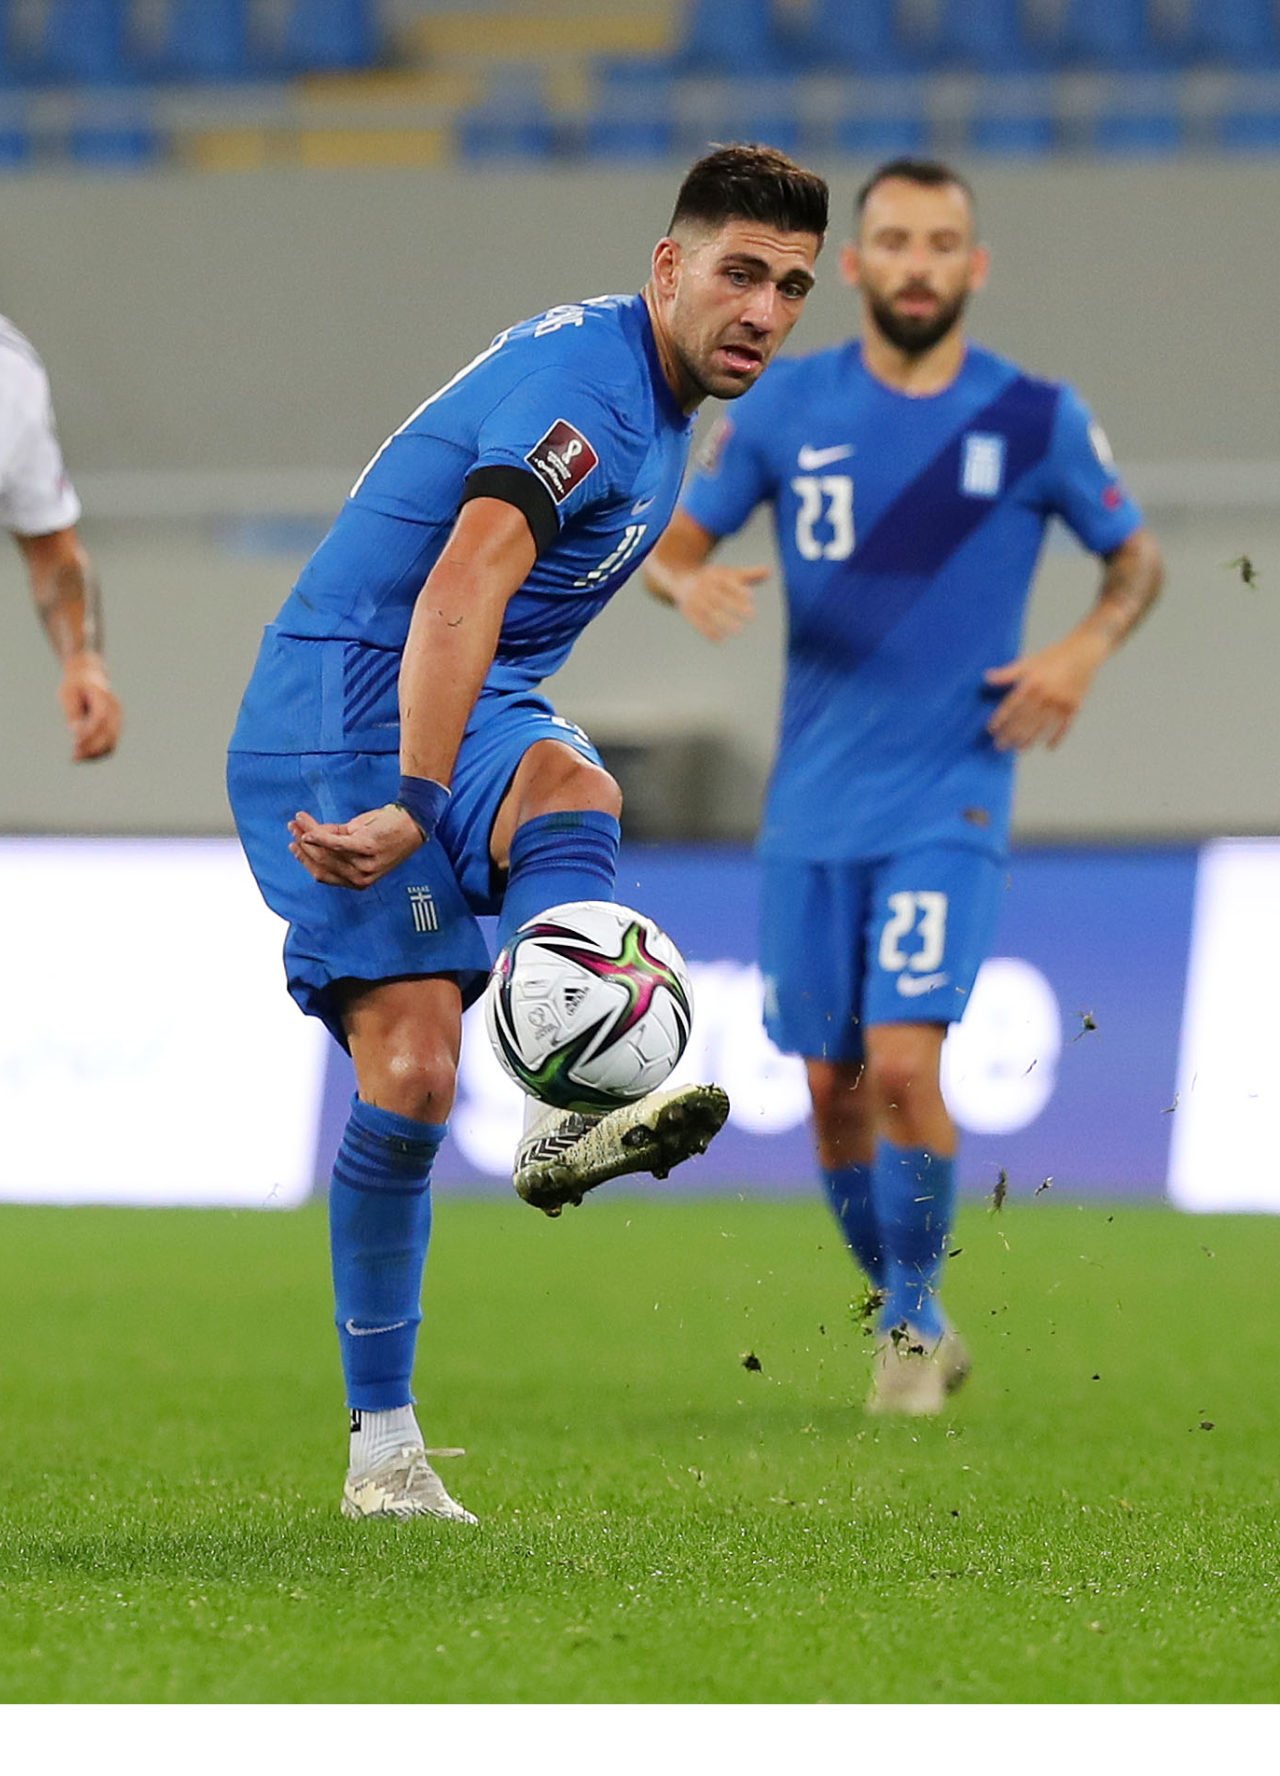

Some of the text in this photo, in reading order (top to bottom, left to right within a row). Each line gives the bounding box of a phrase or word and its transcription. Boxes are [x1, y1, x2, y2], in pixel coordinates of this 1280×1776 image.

[573, 524, 648, 588] 11
[791, 475, 855, 561] 23
[878, 890, 949, 972] 23
